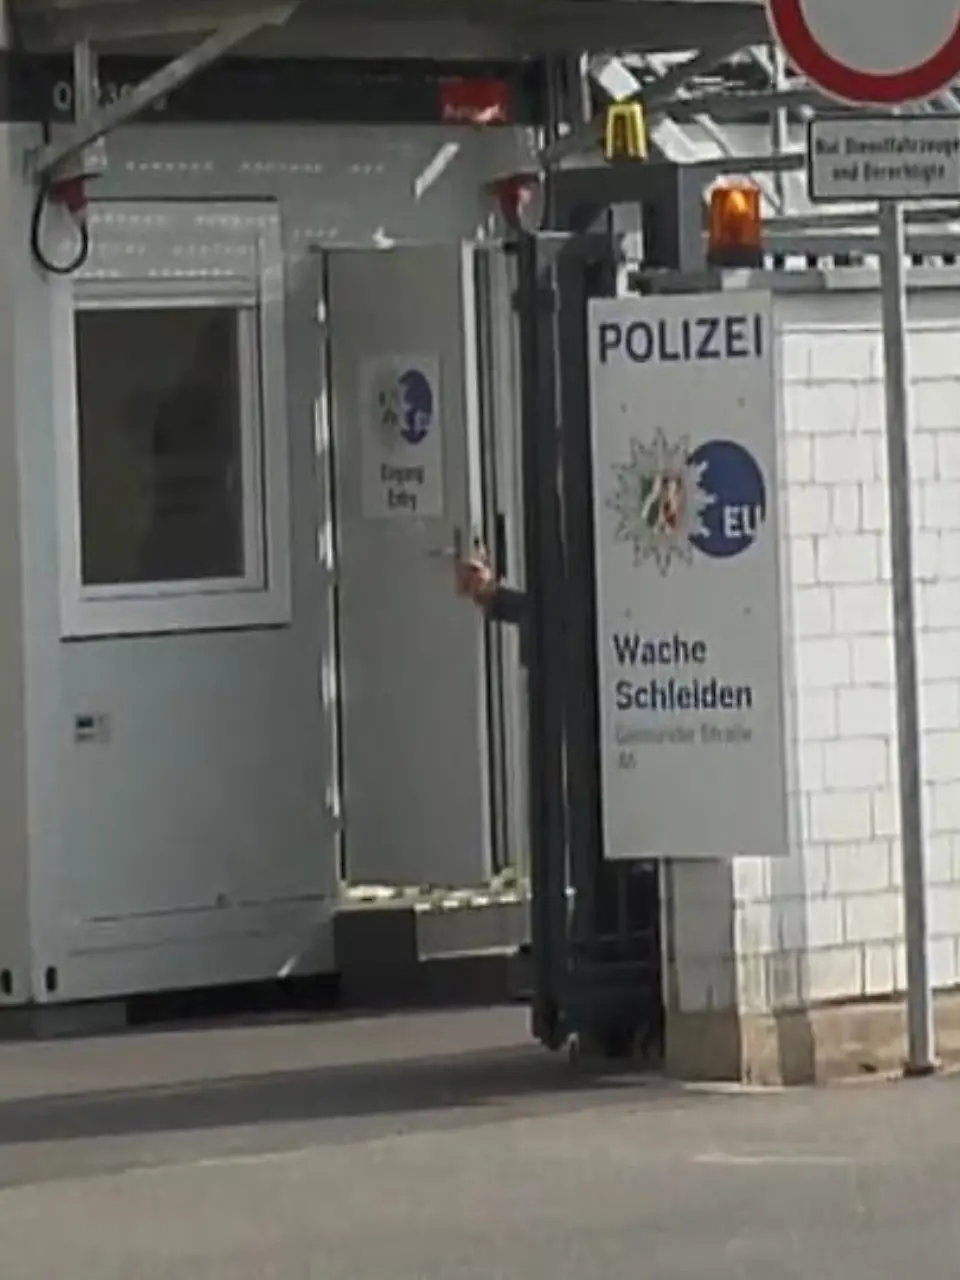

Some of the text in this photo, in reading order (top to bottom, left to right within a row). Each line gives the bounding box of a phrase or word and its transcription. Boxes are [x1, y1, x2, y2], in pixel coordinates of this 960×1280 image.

[599, 313, 763, 365] POLIZEI
[613, 631, 707, 665] Wache
[615, 677, 753, 710] Schleiden
